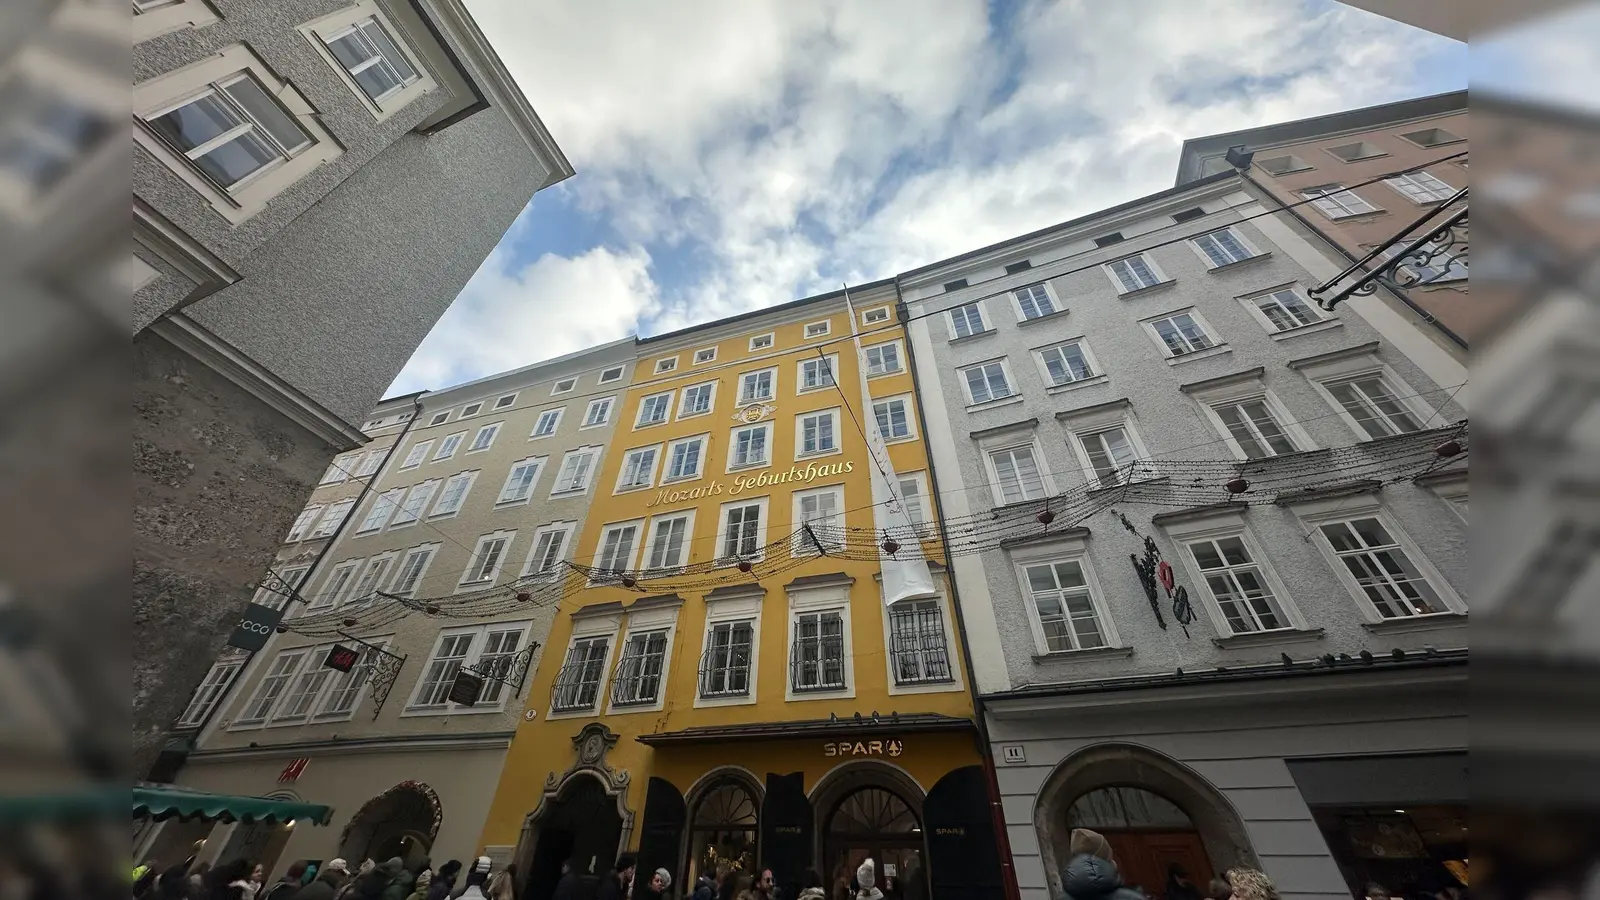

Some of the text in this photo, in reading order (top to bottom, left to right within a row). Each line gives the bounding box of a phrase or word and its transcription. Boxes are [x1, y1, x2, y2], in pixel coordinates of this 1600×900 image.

[646, 460, 854, 508] Mozarts Geburtshaus
[824, 740, 883, 757] SPAR
[1009, 748, 1019, 757] 11
[936, 828, 959, 836] SPAR
